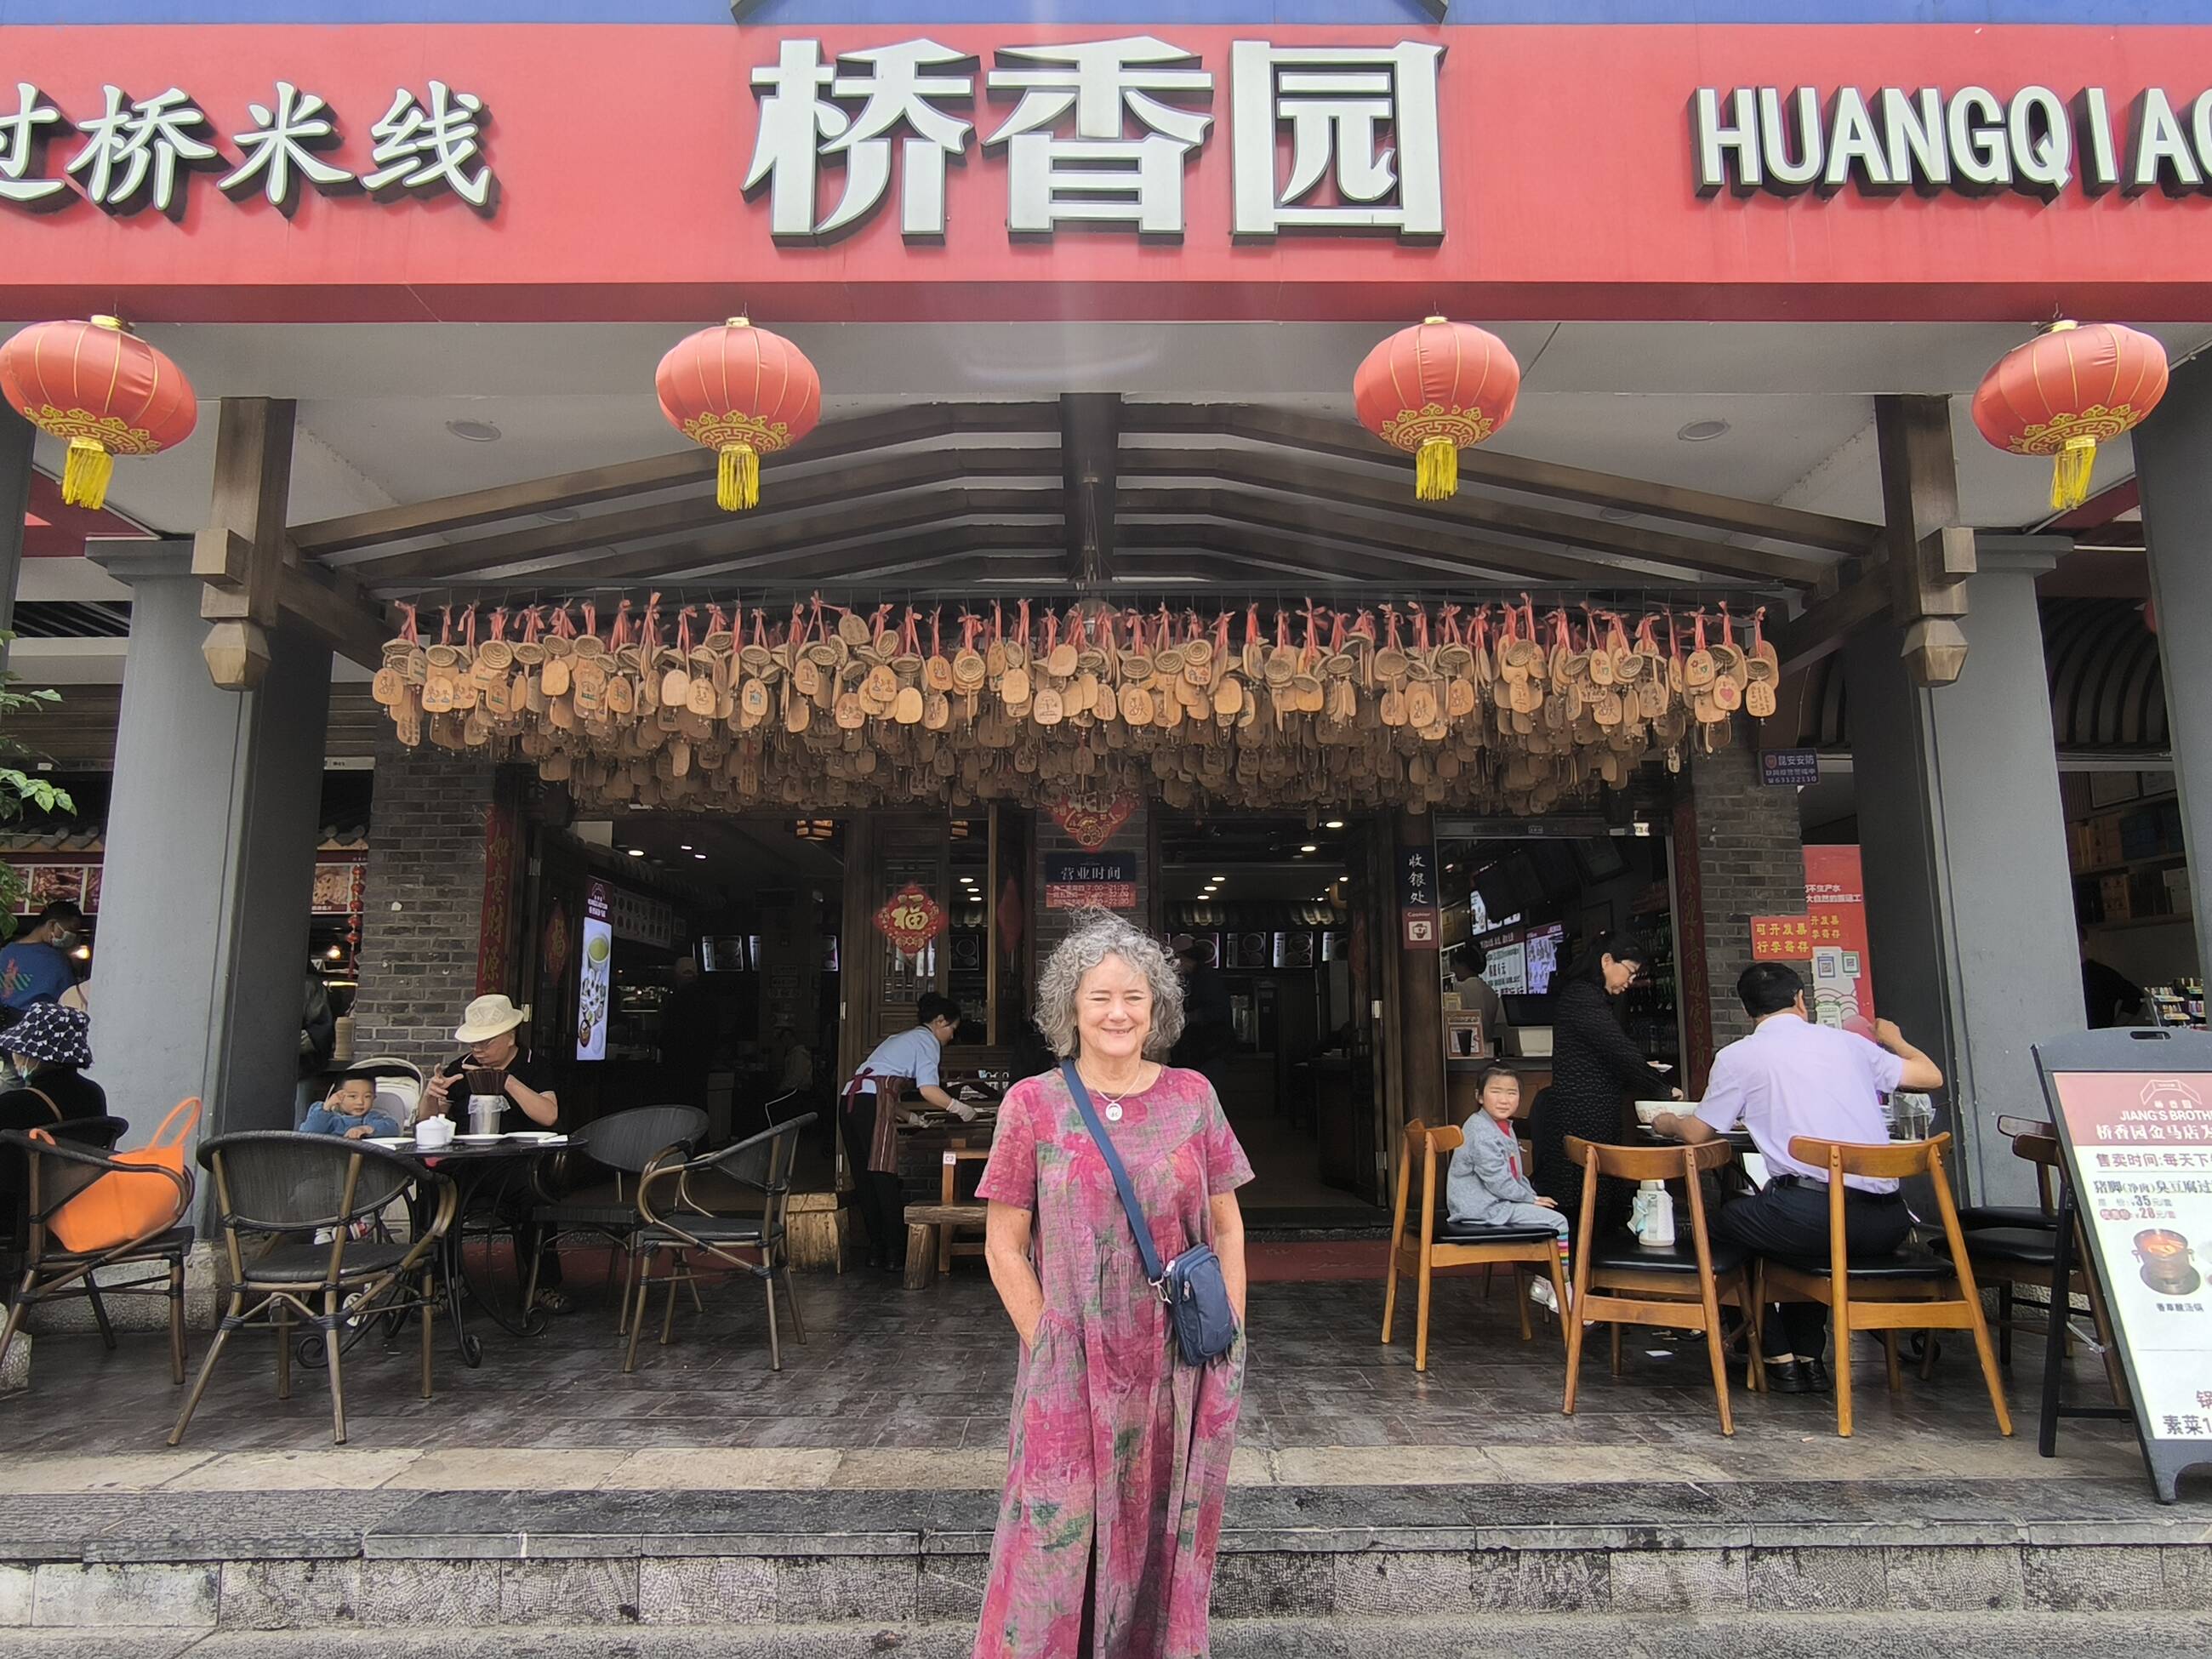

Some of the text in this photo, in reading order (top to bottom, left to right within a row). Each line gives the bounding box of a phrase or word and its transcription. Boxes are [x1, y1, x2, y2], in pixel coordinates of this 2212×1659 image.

[742, 36, 1449, 240] 桥香园
[1061, 866, 1121, 880] 营业时间
[1408, 853, 1428, 904] 收银处
[1756, 923, 1807, 936] 可开发票
[1756, 941, 1810, 953] 行李寄存
[2120, 1109, 2212, 1121] JIANG'S BROTH
[2095, 1153, 2212, 1167] 售卖时间:每天下
